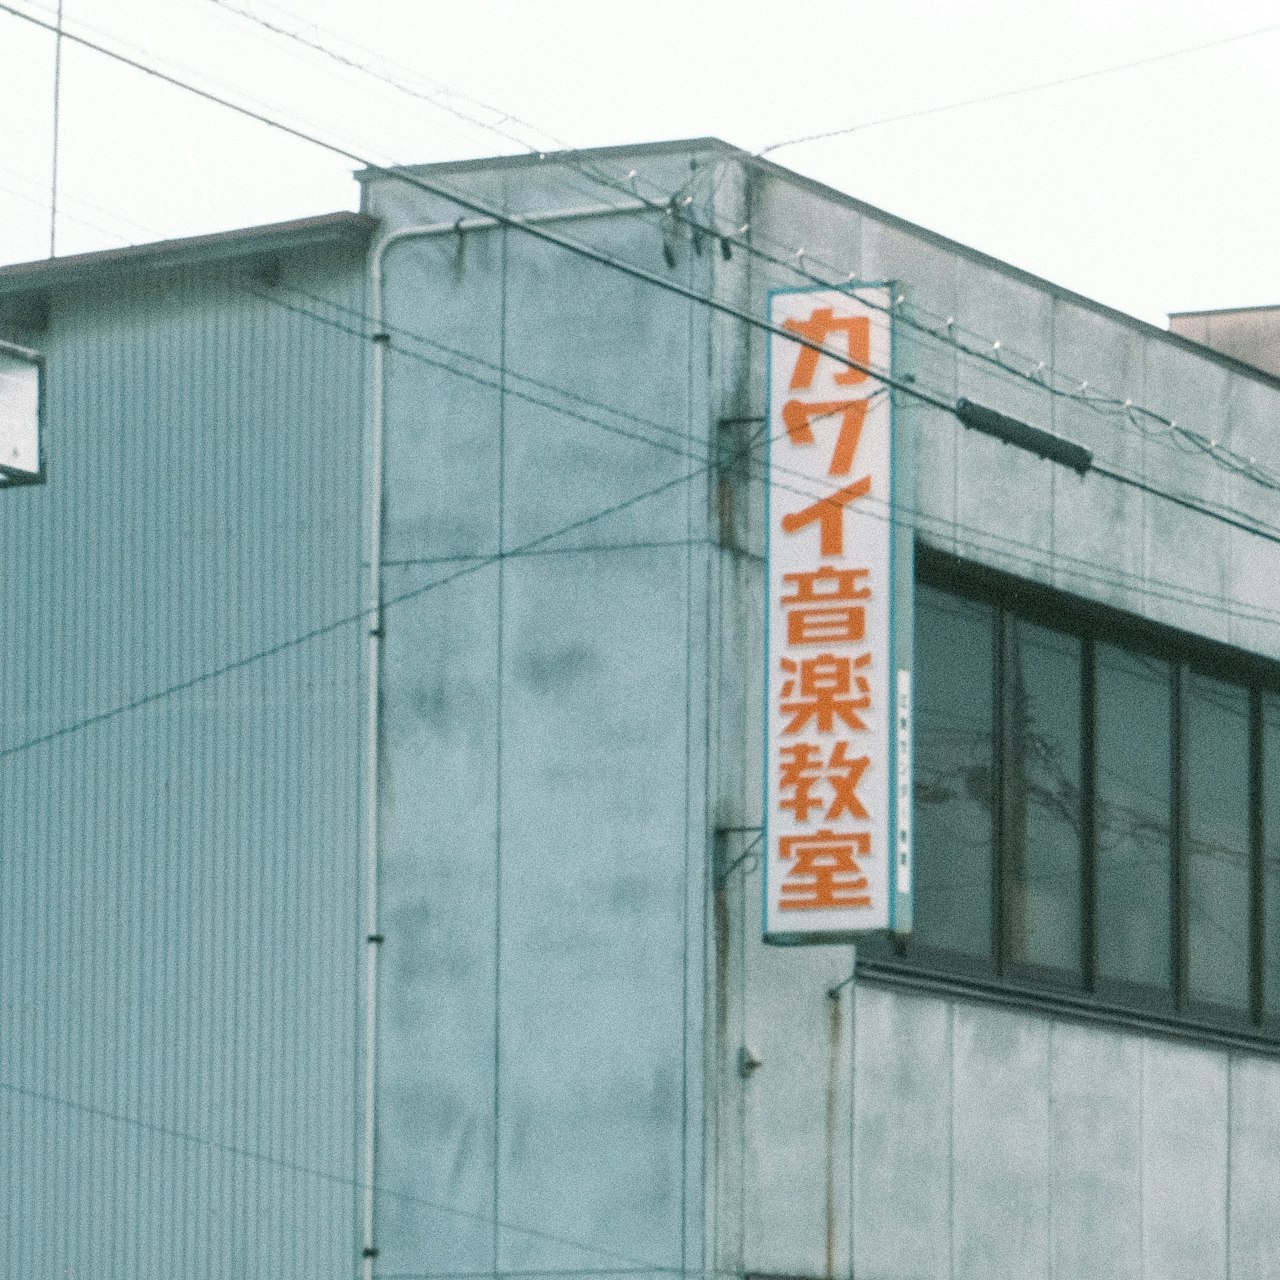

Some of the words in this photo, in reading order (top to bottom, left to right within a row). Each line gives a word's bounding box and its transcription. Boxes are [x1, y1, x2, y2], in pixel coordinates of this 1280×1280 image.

[778, 306, 873, 911] カワイ音楽教室
